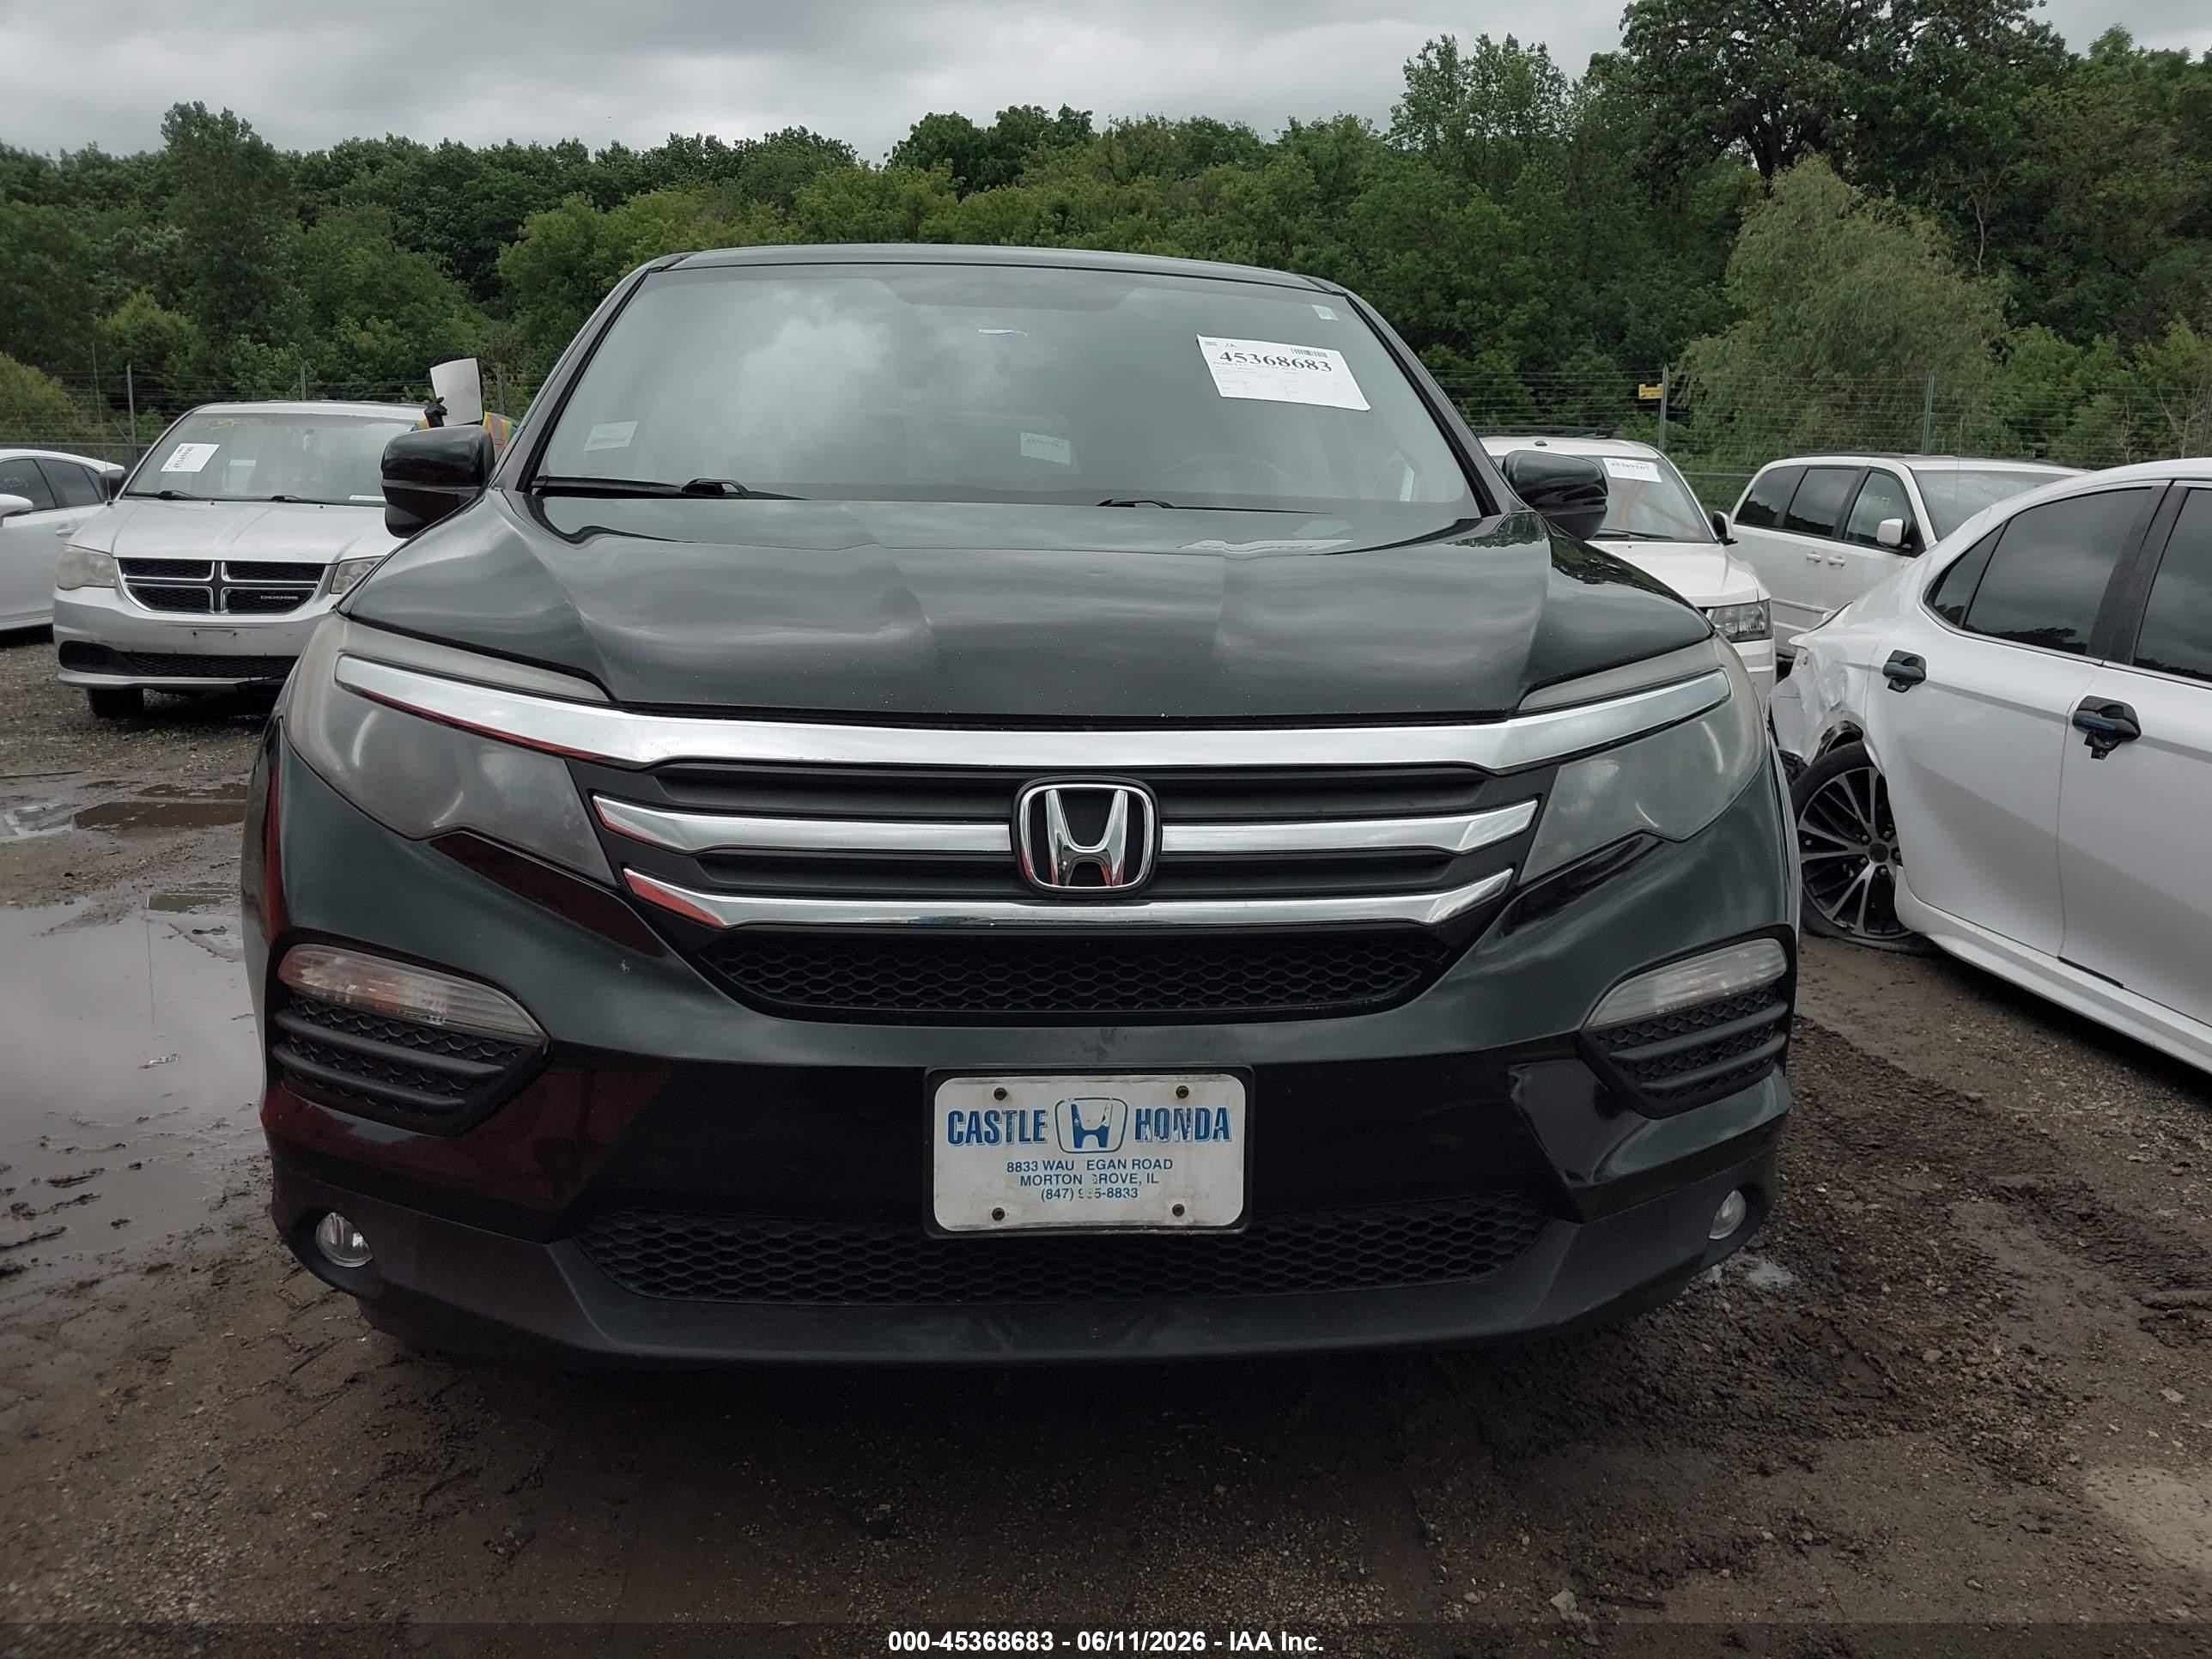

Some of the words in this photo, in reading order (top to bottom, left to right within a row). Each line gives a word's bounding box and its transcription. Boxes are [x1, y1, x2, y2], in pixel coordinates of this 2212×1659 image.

[1218, 350, 1333, 373] 45368683
[947, 1109, 1048, 1146] CASTLE
[1134, 1106, 1231, 1142] HONDA
[1006, 1160, 1038, 1173] 8833
[1042, 1159, 1127, 1171] WAUEGAN
[1132, 1158, 1173, 1170] ROAD
[1020, 1174, 1083, 1186] MORTON
[1146, 1172, 1159, 1184] IL
[1041, 1188, 1074, 1201] (847)
